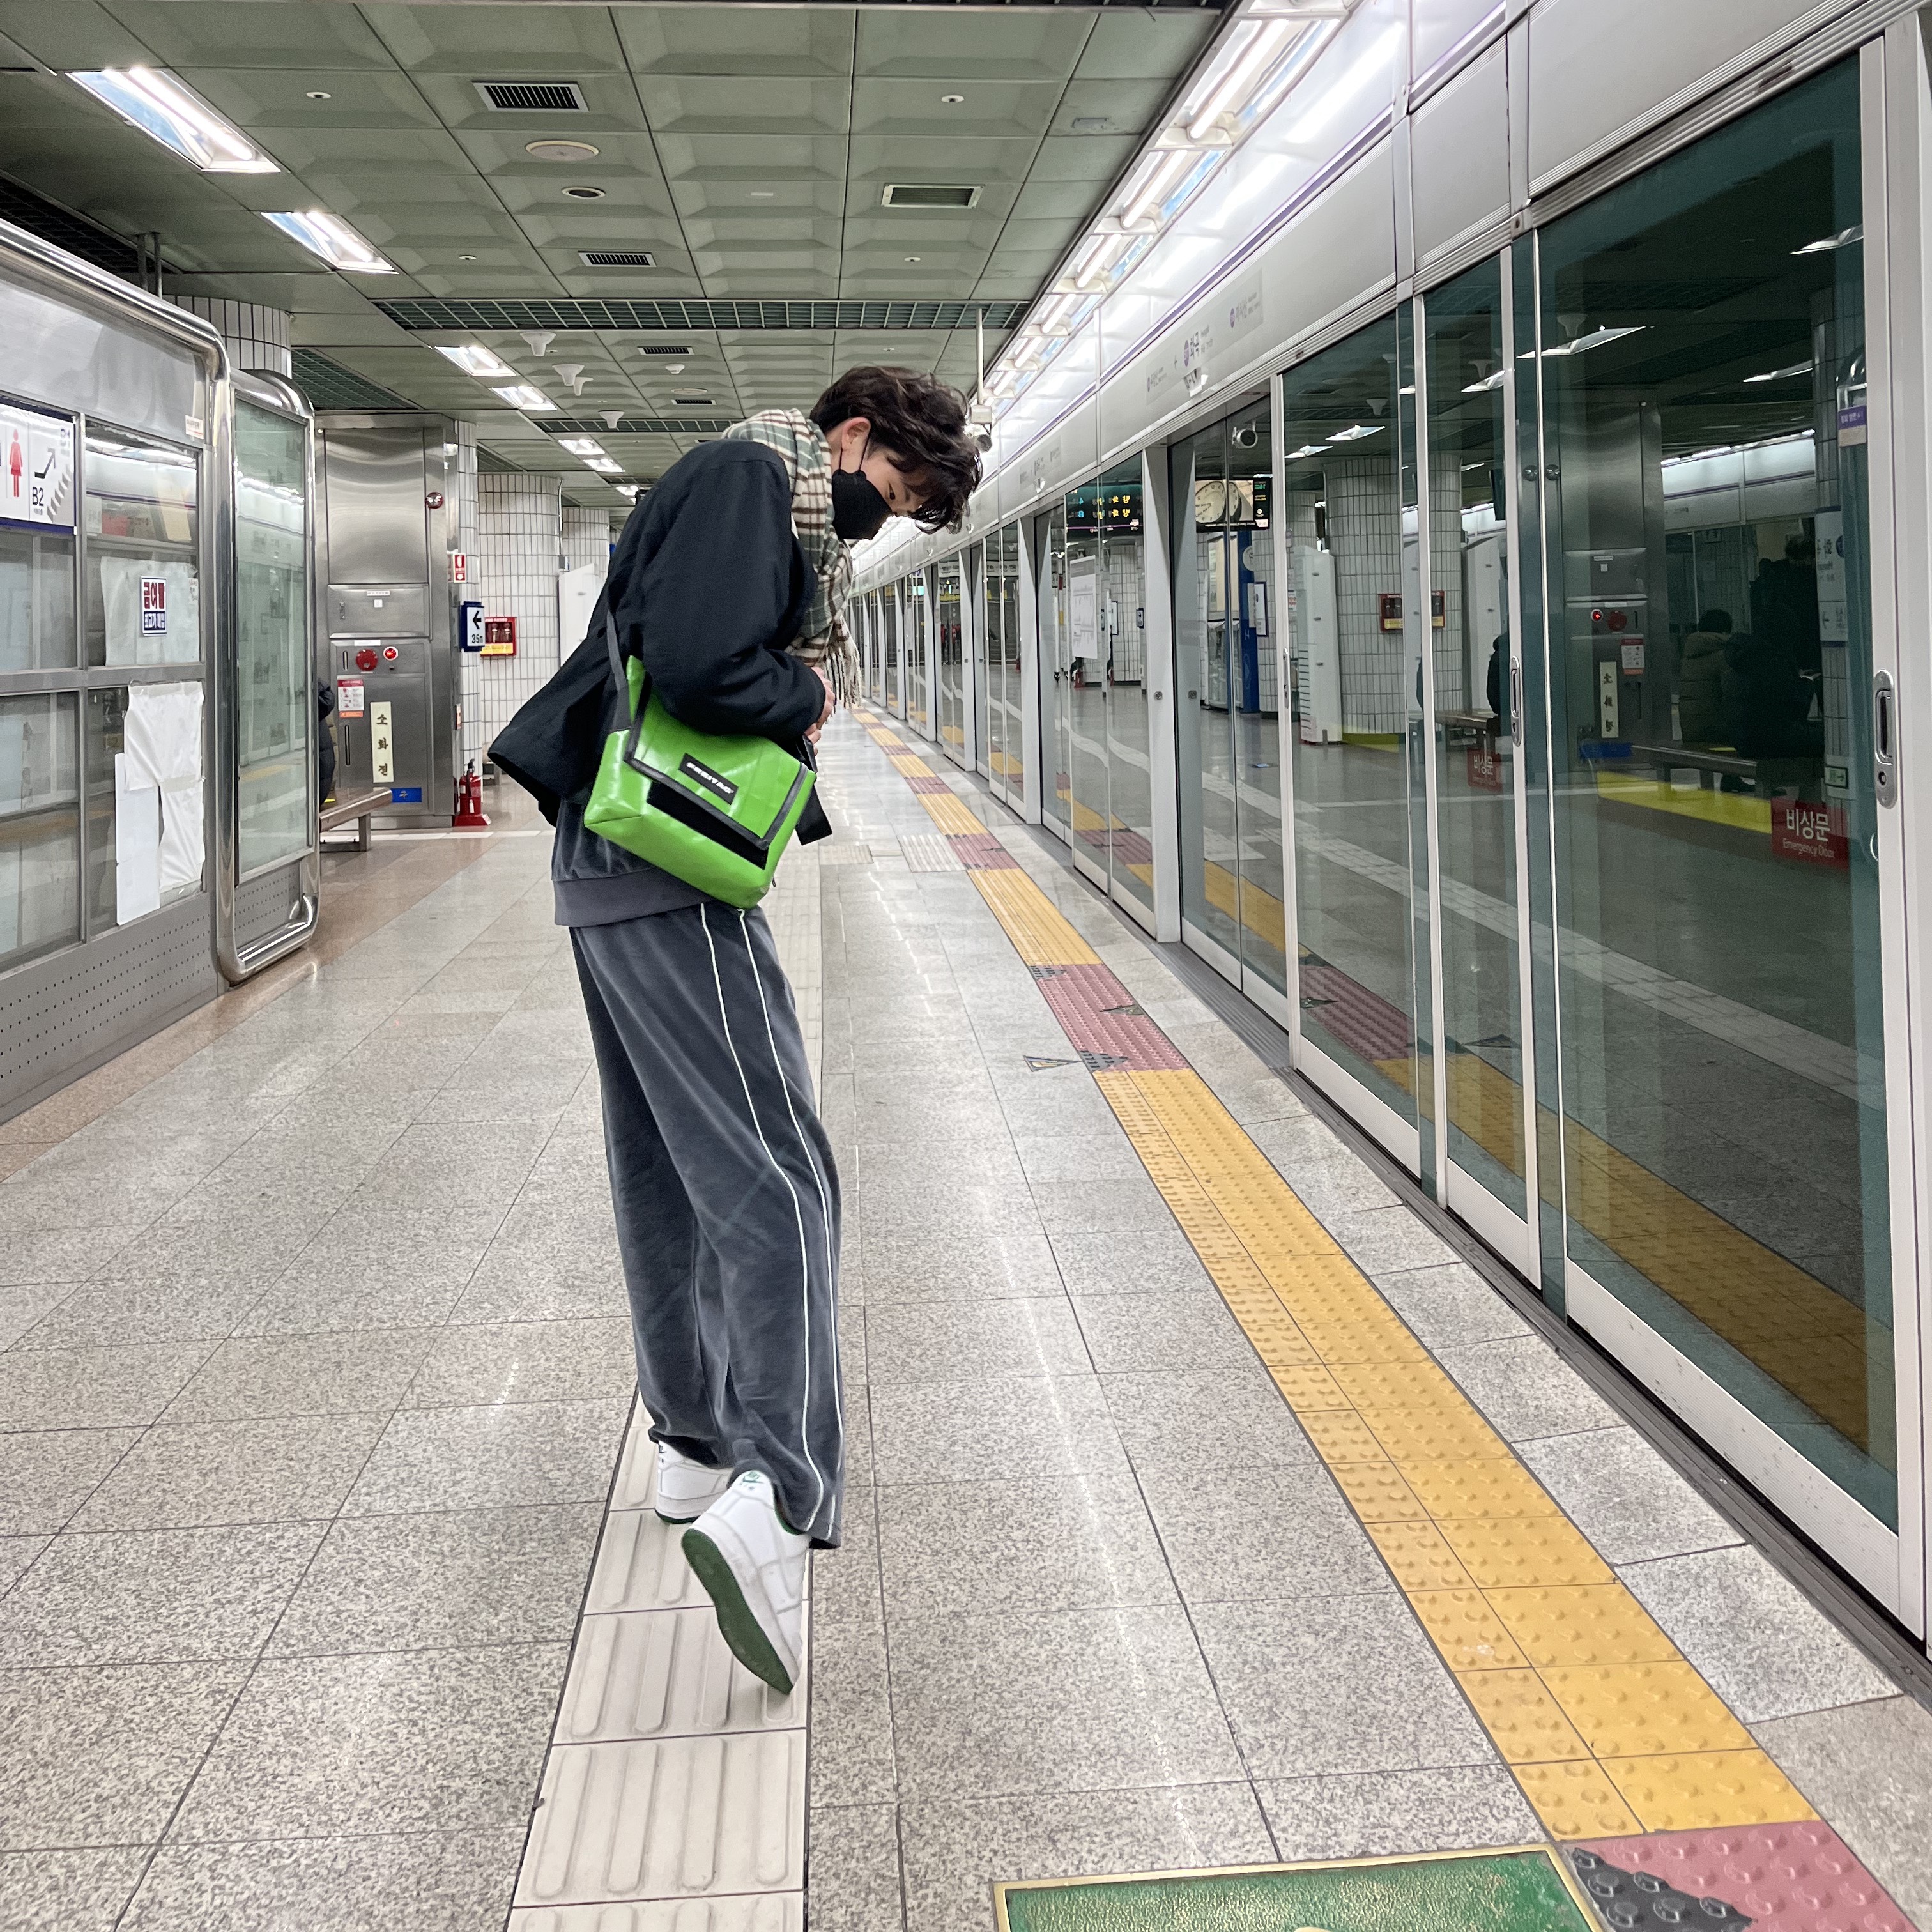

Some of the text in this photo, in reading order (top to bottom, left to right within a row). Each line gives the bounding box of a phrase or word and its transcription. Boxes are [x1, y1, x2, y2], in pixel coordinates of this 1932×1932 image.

[32, 486, 44, 507] B2
[376, 714, 389, 776] 소화전
[686, 762, 735, 793] FREITAG
[1786, 808, 1830, 841] 비상문
